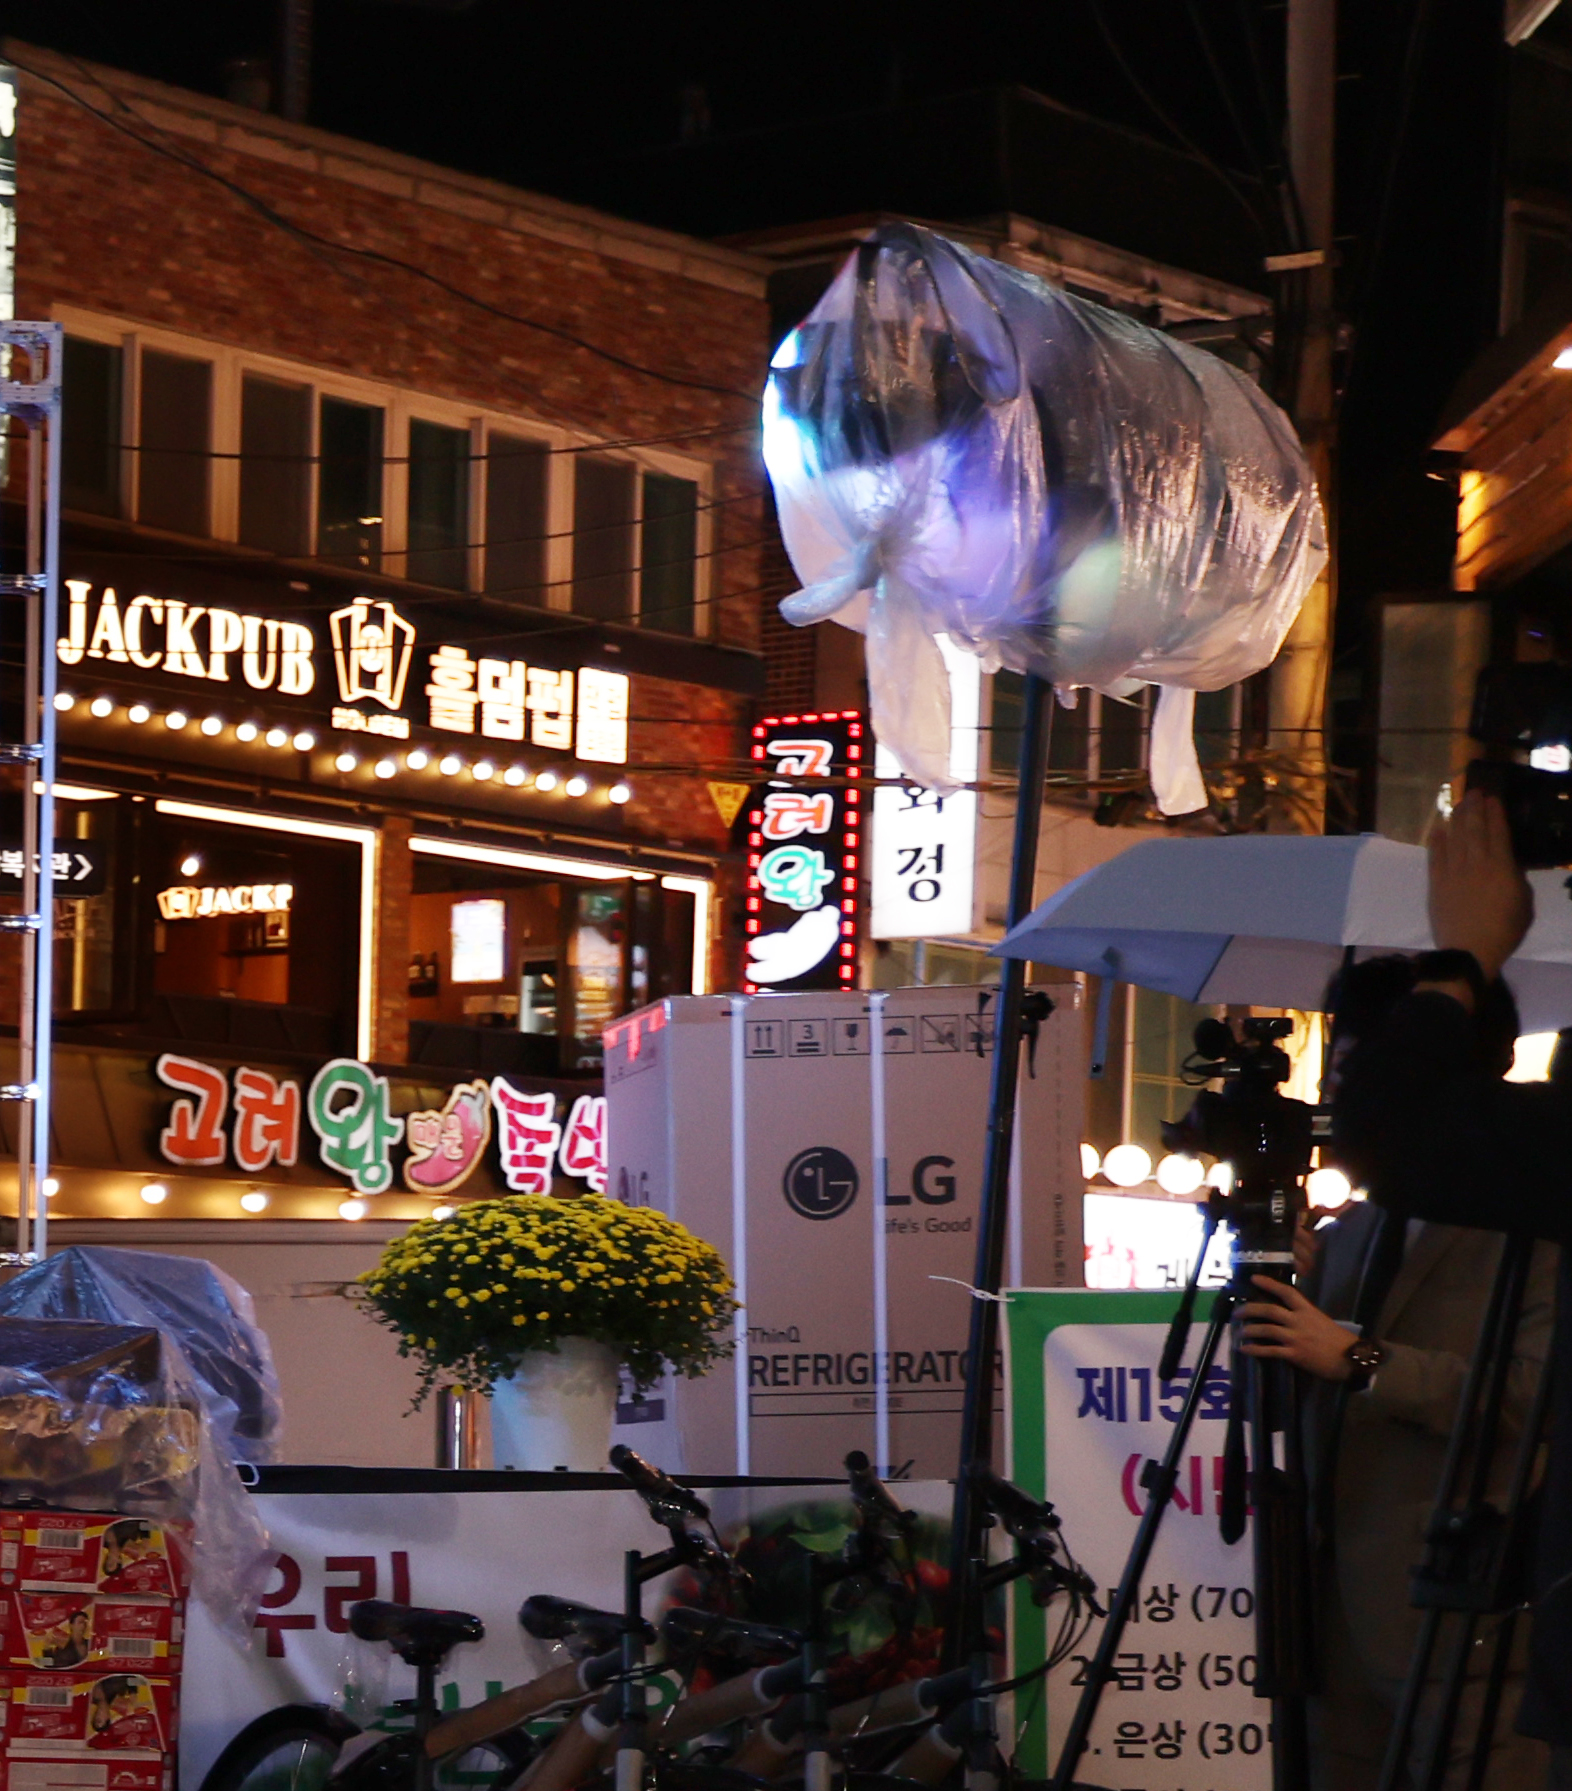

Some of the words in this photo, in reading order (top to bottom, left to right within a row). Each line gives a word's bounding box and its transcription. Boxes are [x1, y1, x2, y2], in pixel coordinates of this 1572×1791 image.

[56, 580, 316, 696] JACKPUB
[883, 1155, 957, 1206] LG
[883, 1218, 919, 1235] ife's
[925, 1215, 972, 1234] Good
[1113, 1721, 1187, 1760] 은상
[1197, 1721, 1273, 1760] (30
